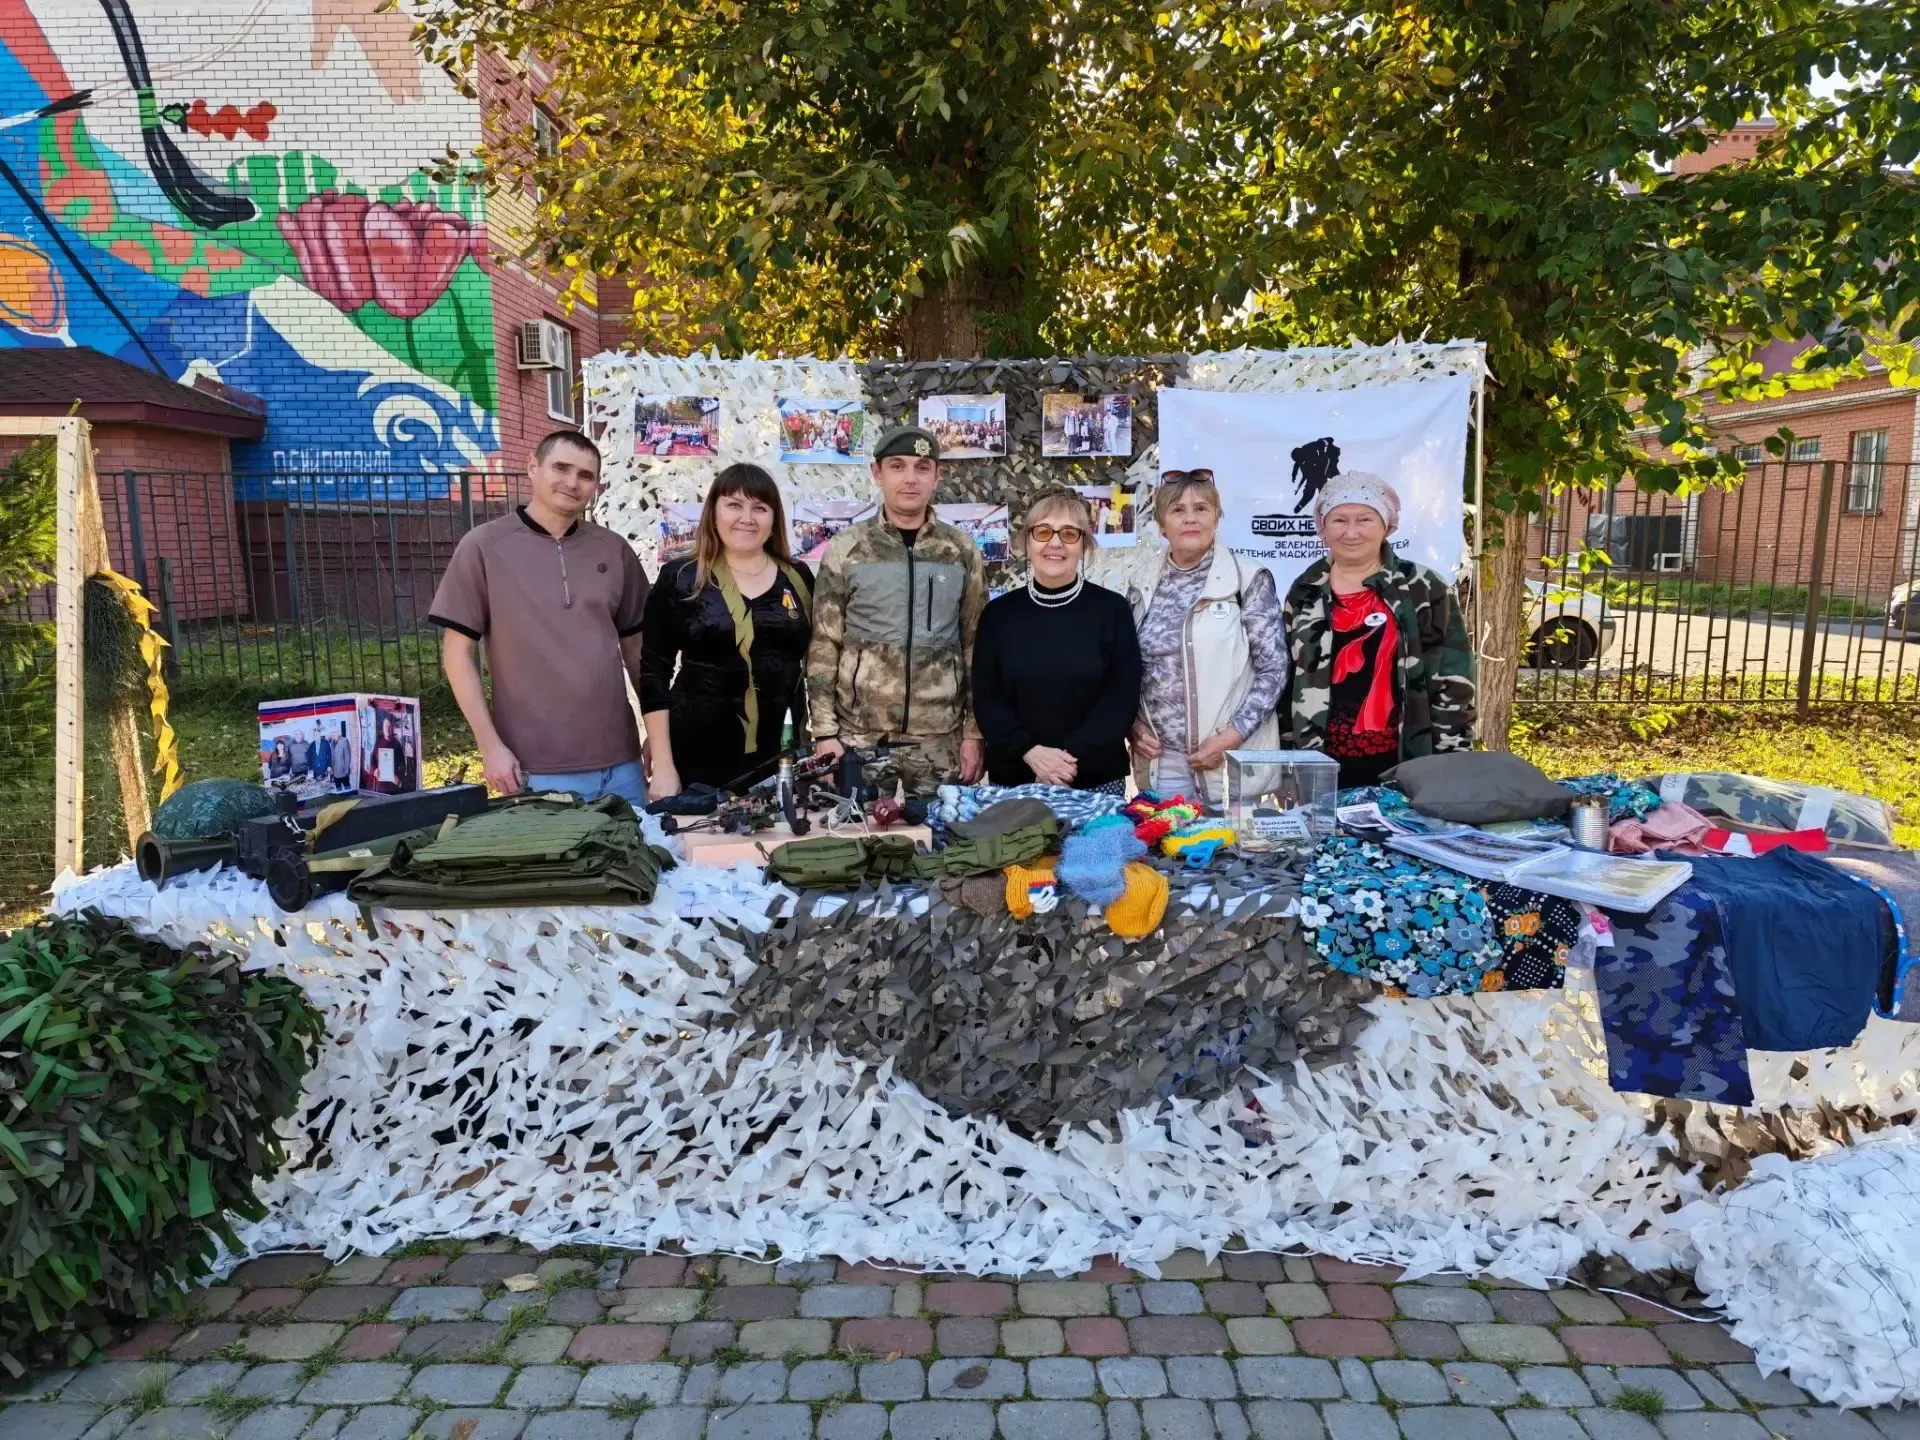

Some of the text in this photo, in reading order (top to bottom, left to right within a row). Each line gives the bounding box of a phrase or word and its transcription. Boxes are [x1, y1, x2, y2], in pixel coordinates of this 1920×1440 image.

[1251, 519, 1316, 531] СВОИХ НЕ
[1390, 538, 1410, 550] ТЕЙ
